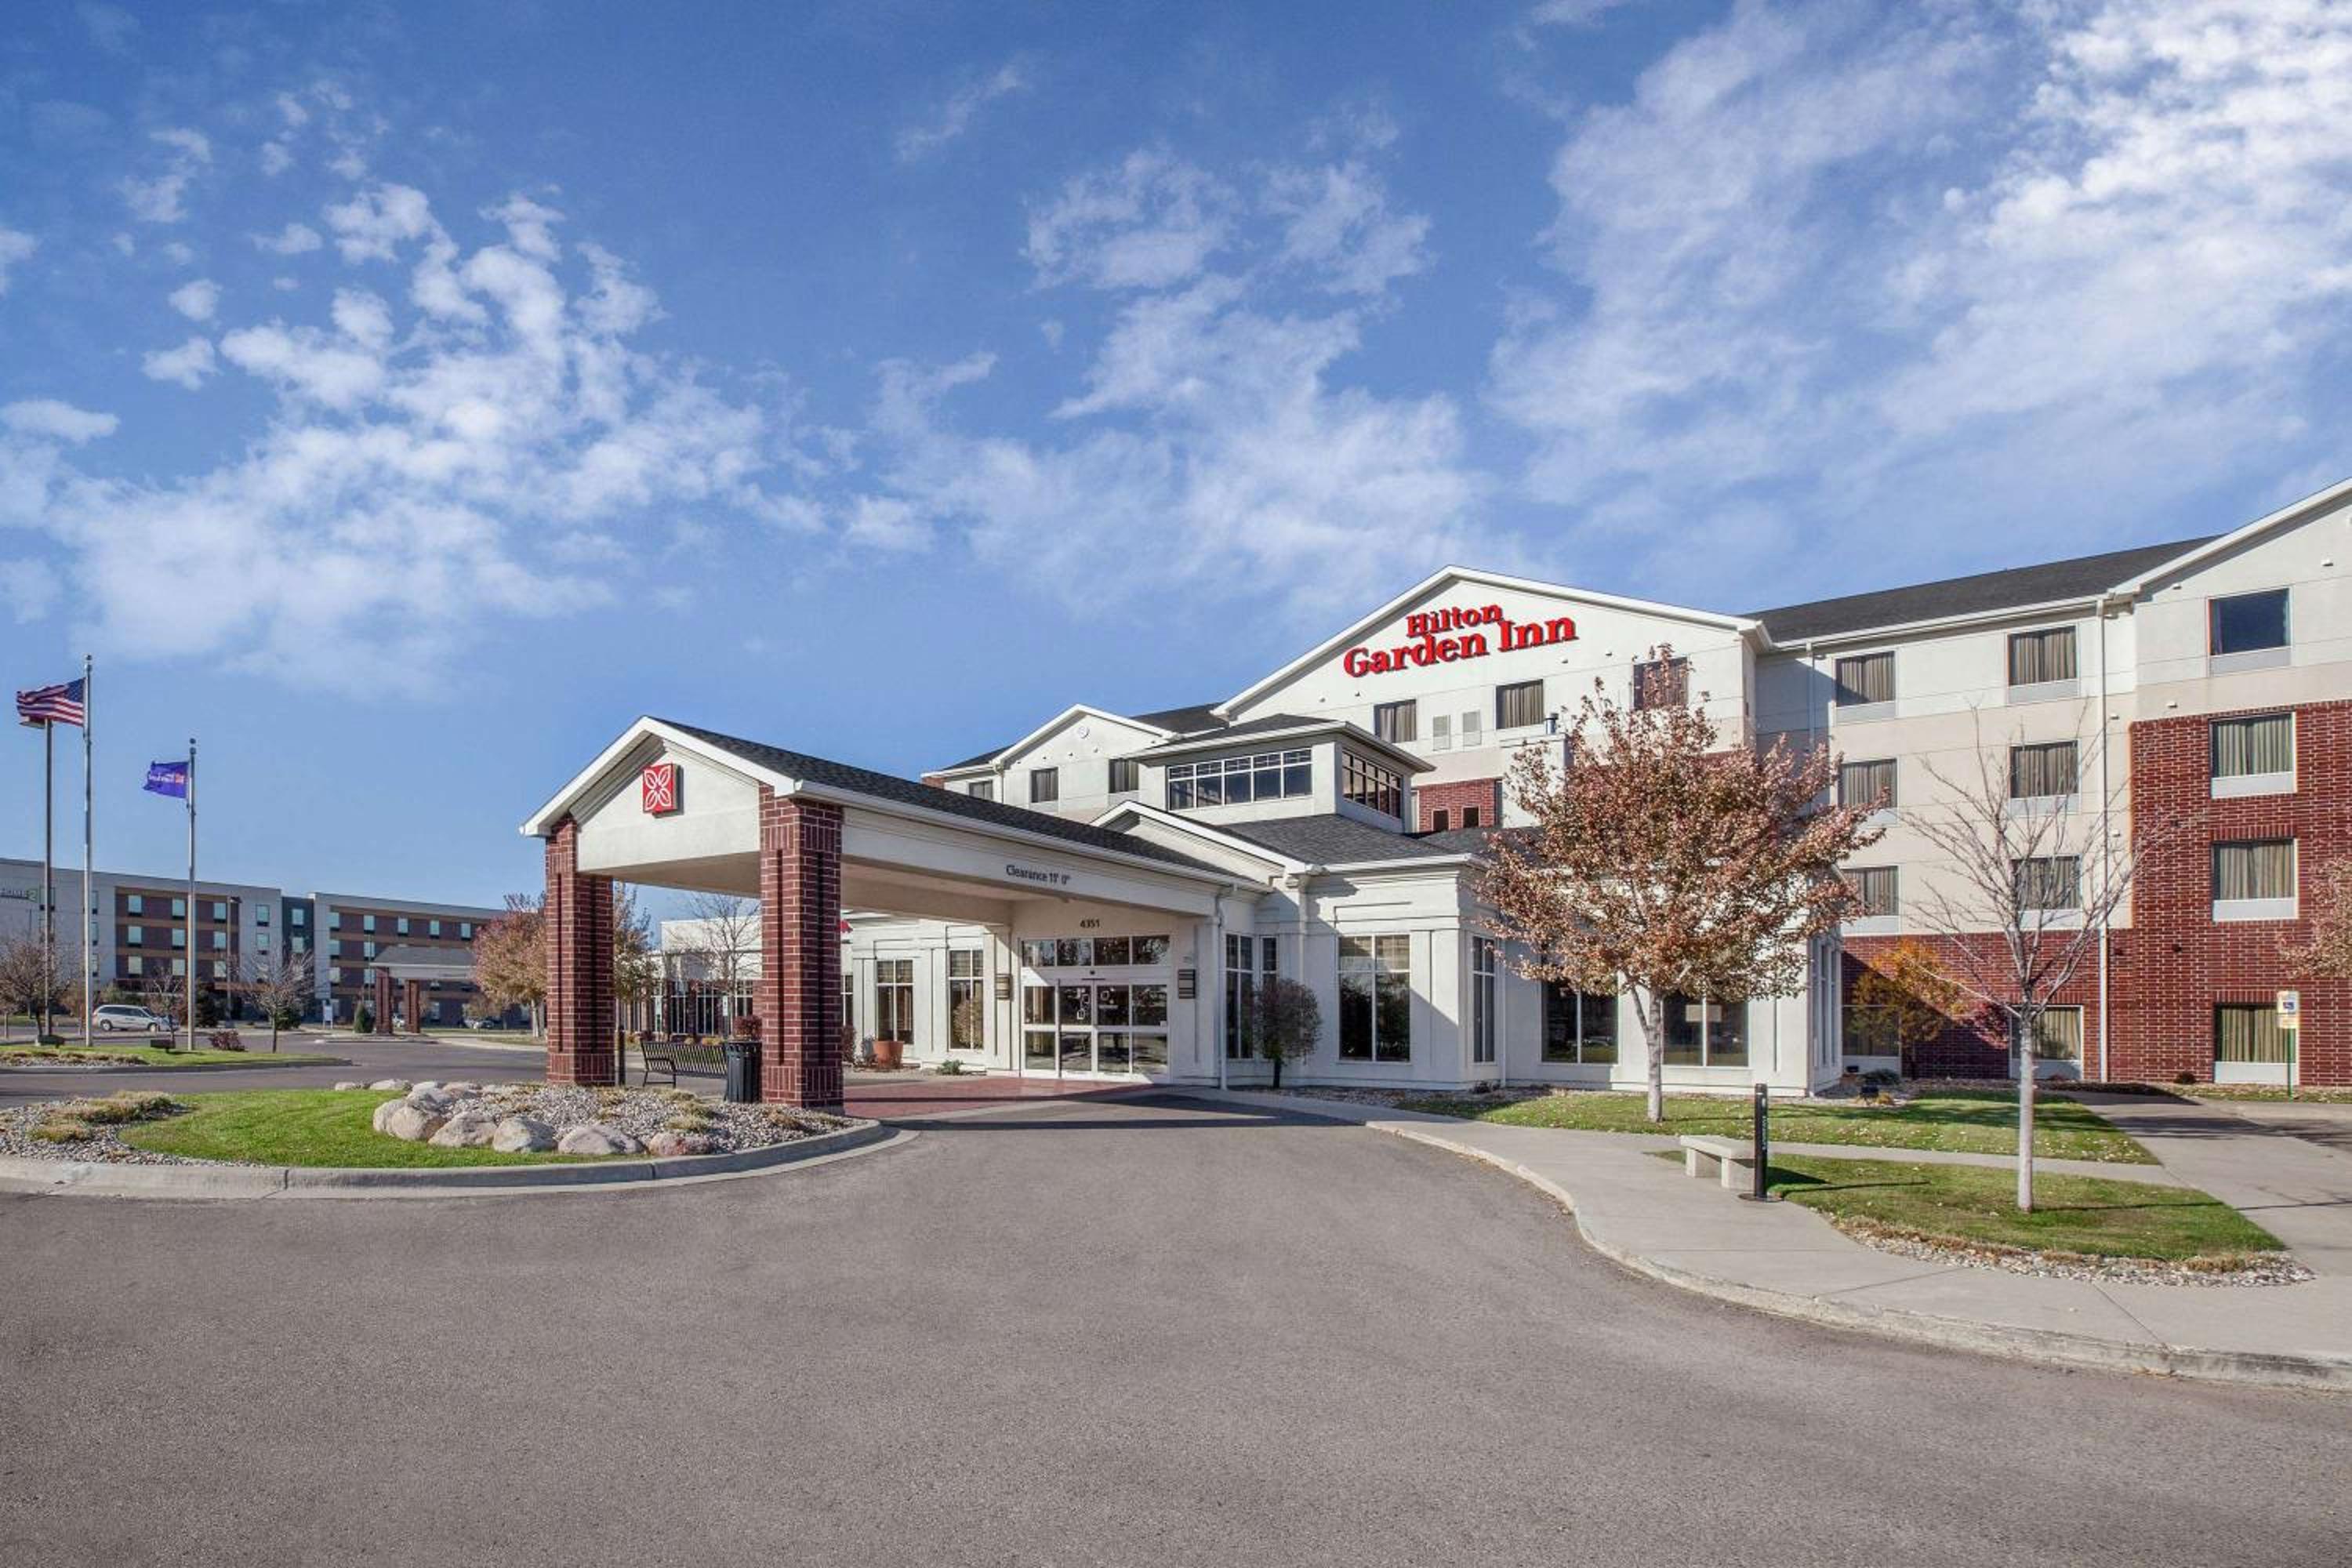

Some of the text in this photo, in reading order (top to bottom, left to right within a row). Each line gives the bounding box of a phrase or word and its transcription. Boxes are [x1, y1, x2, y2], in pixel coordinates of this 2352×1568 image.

[1406, 604, 1504, 637] Hilton
[1343, 616, 1580, 677] Garden Inn
[1006, 865, 1047, 882] Clearance
[1080, 918, 1100, 928] 4351
